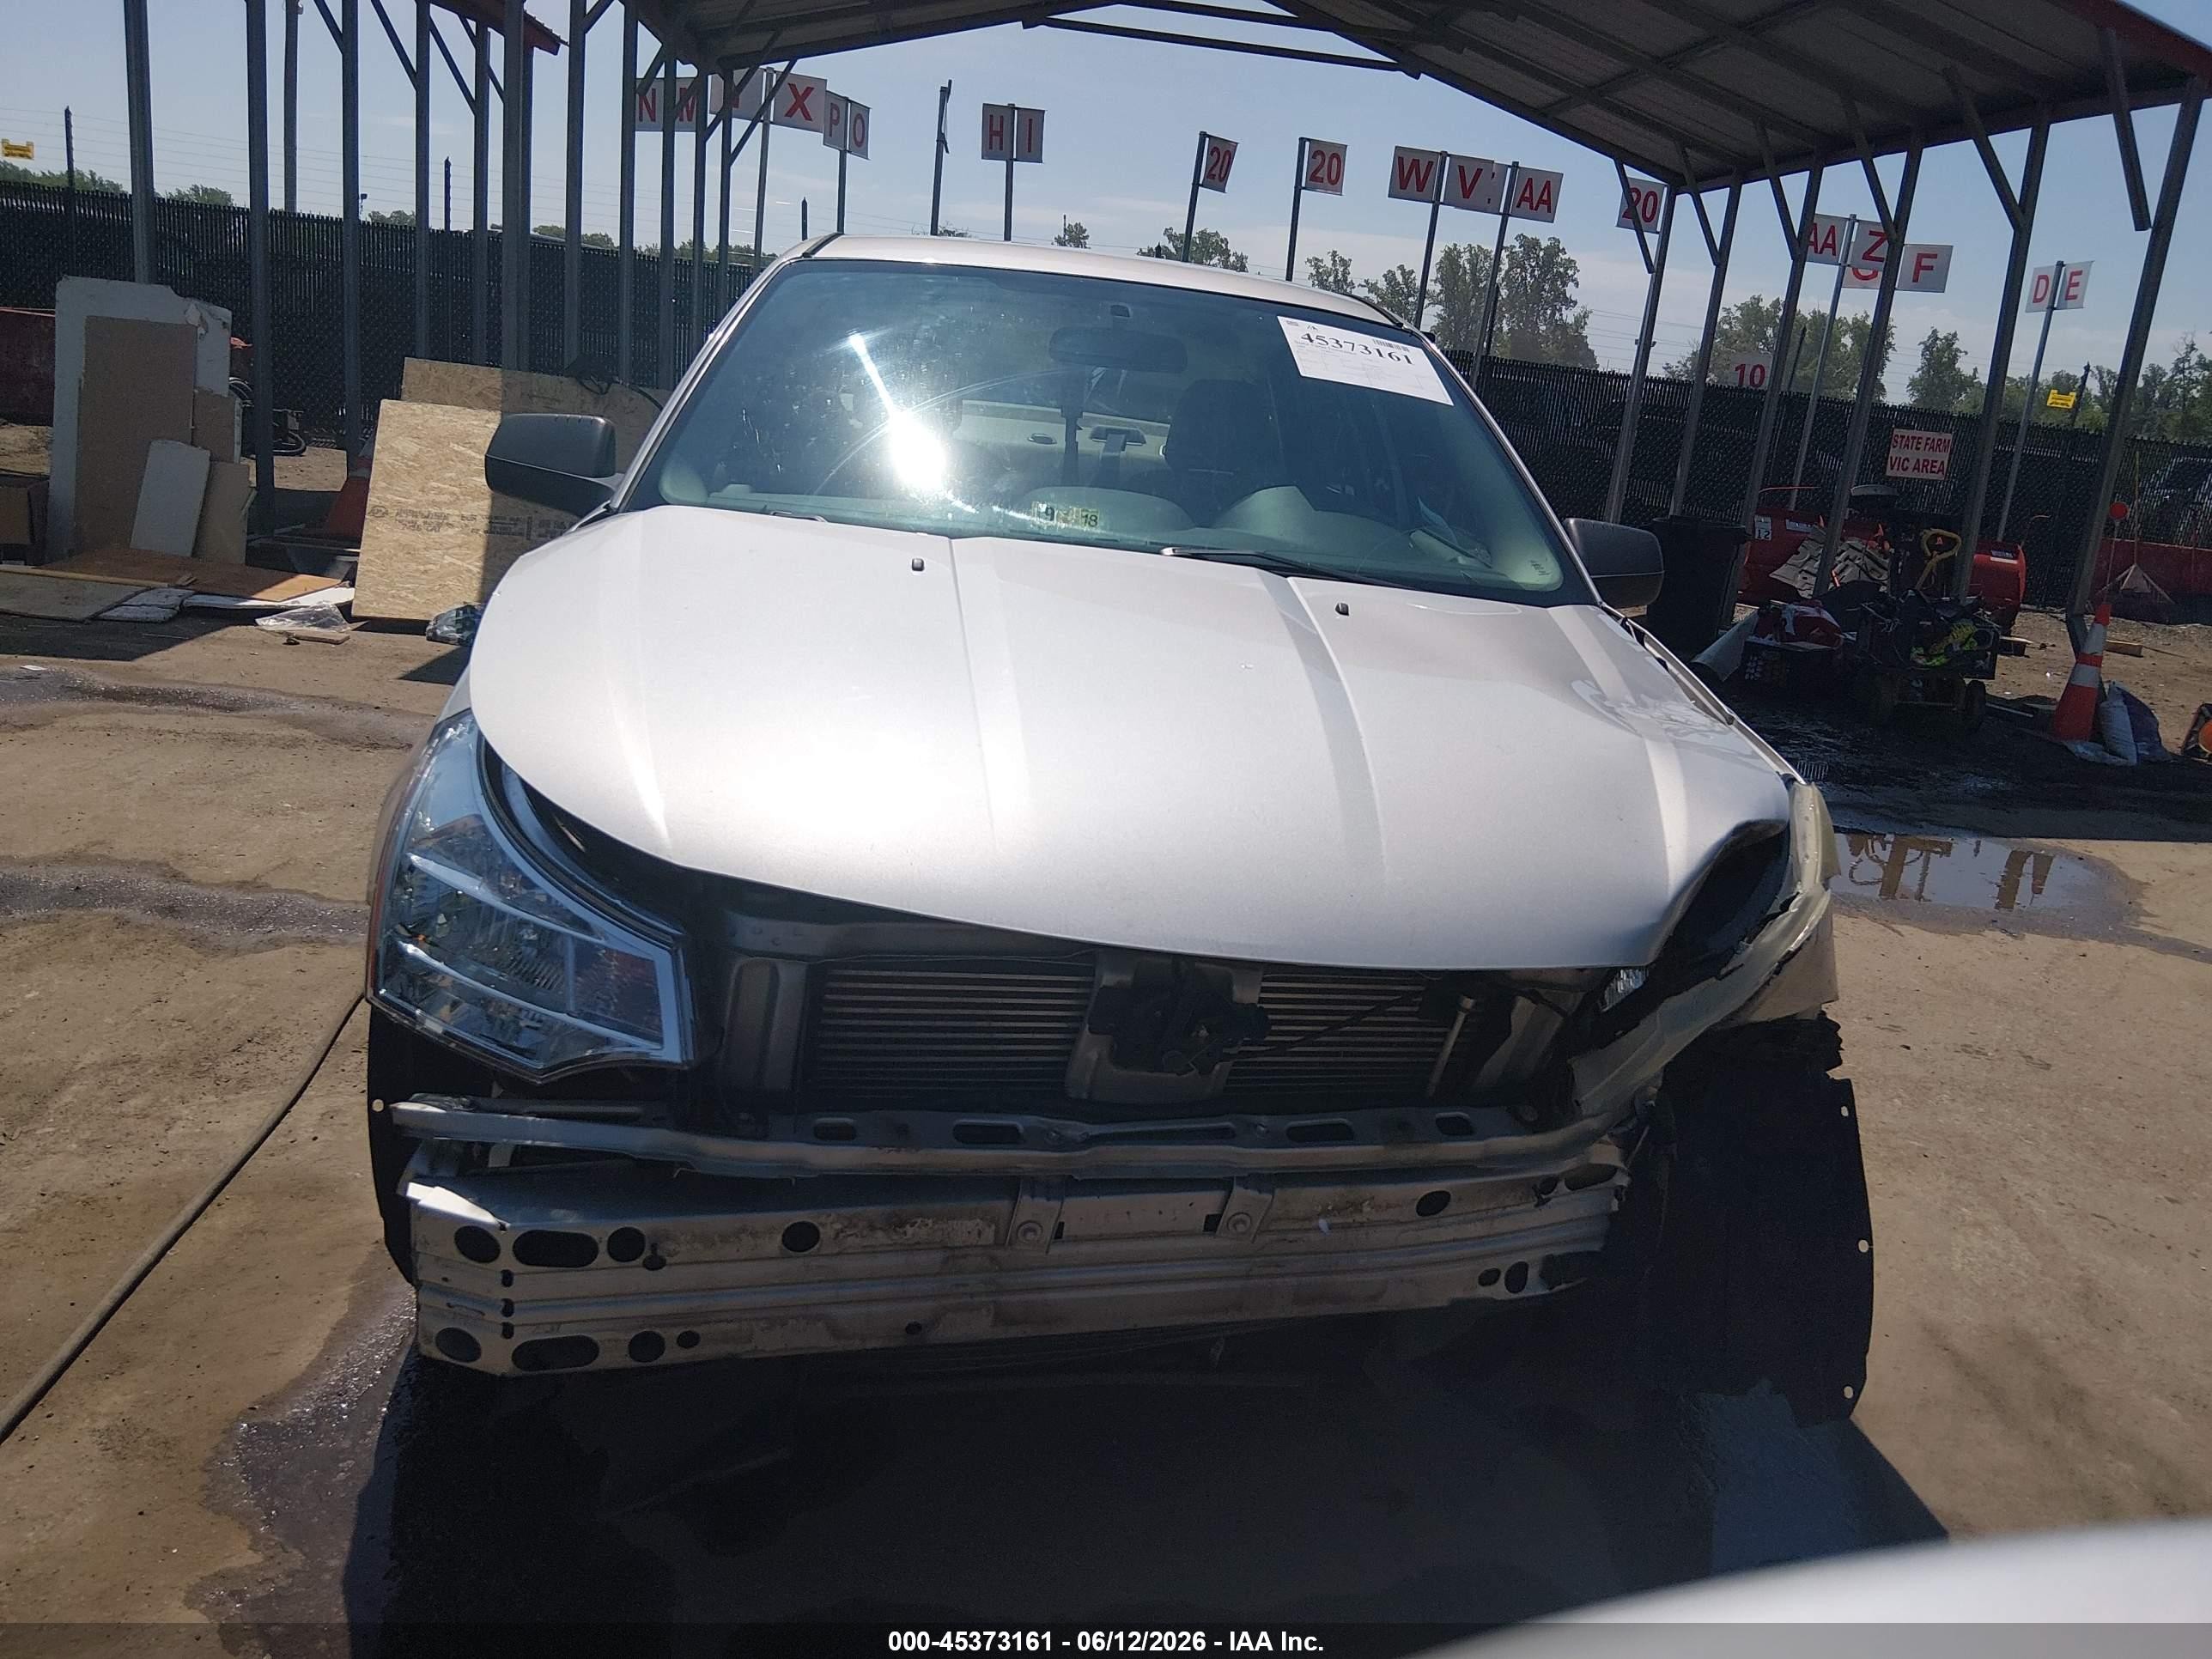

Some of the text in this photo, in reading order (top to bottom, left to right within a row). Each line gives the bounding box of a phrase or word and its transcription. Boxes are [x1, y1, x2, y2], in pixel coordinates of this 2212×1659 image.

[639, 88, 656, 122] N
[784, 82, 815, 122] X
[830, 102, 841, 137] P
[853, 112, 866, 148] O
[988, 114, 1004, 151] H
[1027, 118, 1033, 153] I
[1206, 146, 1231, 182] 20
[1309, 149, 1341, 185] 20
[1397, 155, 1434, 192] W
[1458, 164, 1484, 199] V
[1516, 177, 1552, 214] AA
[1622, 186, 1658, 223] 20
[1808, 222, 1837, 257] AA
[1862, 230, 1888, 263] Z
[1911, 252, 1938, 283] F
[2032, 274, 2050, 304] D
[2064, 270, 2083, 301] E
[1300, 331, 1416, 365] 45373161
[1735, 363, 1765, 388] 10
[1892, 434, 1951, 453] STATE FARM
[1889, 455, 1945, 475] VIC AREA
